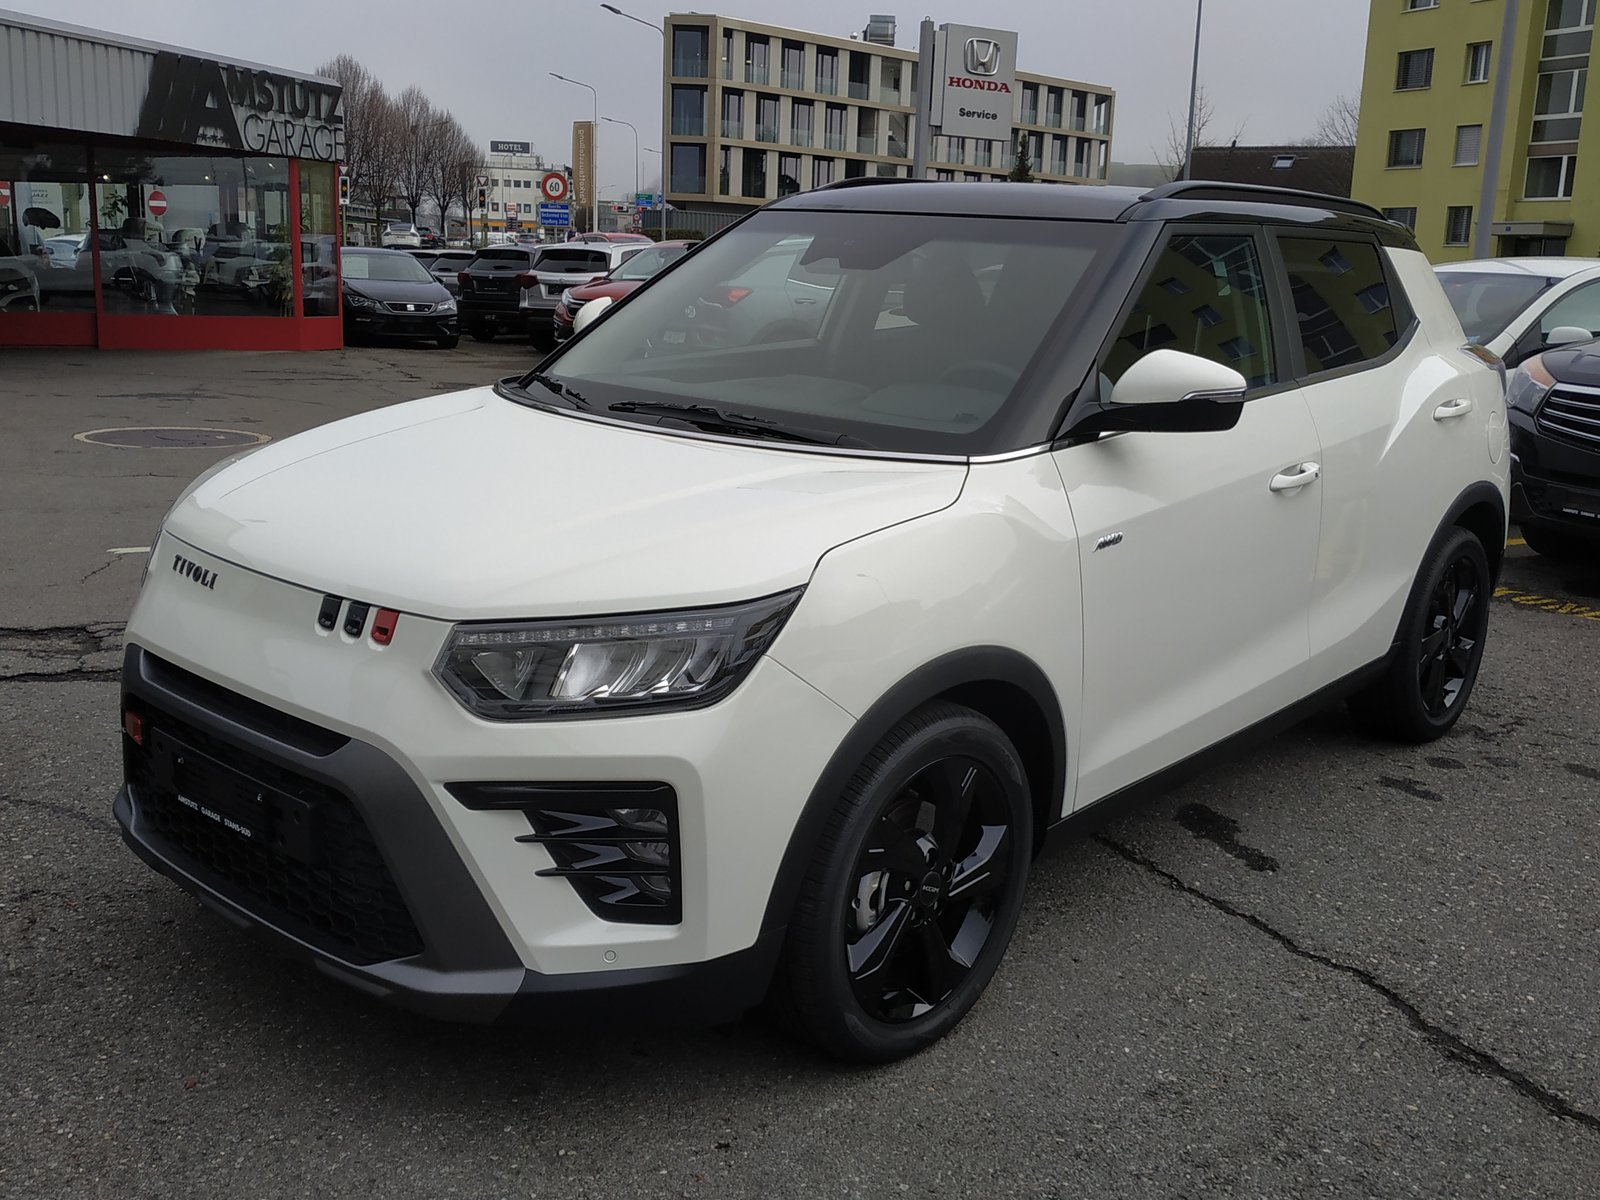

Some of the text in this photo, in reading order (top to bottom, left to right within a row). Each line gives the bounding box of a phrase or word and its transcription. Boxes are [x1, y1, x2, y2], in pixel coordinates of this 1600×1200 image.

[947, 76, 1012, 94] HONDA
[181, 58, 343, 149] AMSTUTZ
[958, 107, 998, 121] Service
[243, 113, 345, 162] GARAGE
[498, 143, 523, 151] HOTEL
[549, 182, 560, 192] 60
[172, 554, 218, 590] TIVOLI
[177, 794, 199, 811] AMSTUTZ
[200, 806, 222, 823] GARAGE
